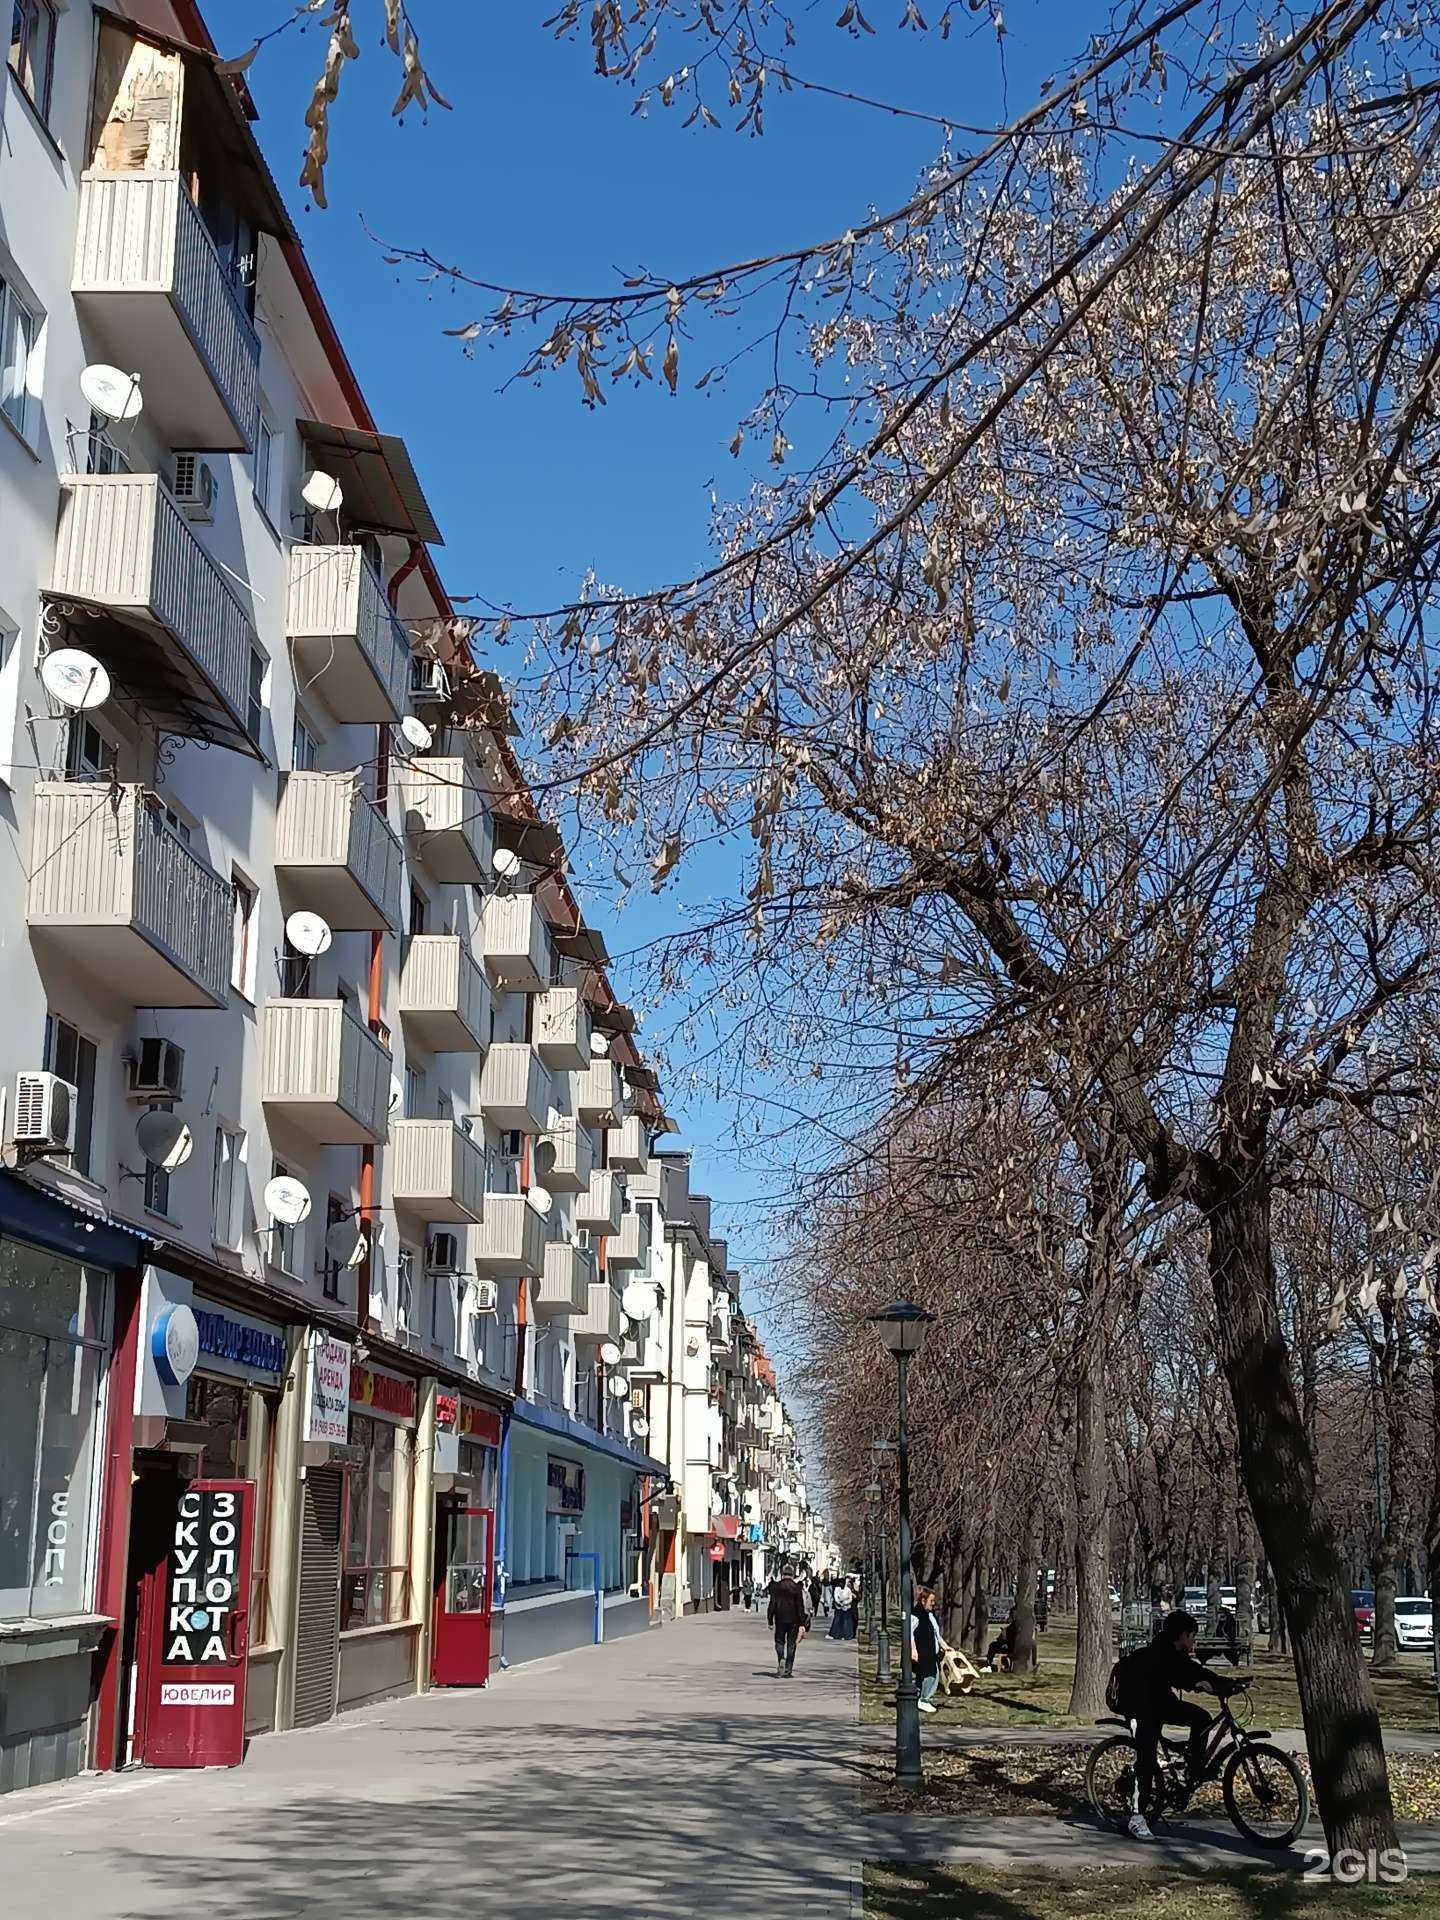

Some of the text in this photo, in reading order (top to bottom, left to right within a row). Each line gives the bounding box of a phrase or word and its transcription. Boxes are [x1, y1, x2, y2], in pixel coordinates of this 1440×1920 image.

[319, 1367, 343, 1390] АРЕНДА
[166, 1493, 200, 1661] СКУПКА
[200, 1493, 236, 1661] ЗОЛОТА
[164, 1688, 232, 1701] ЮВЕЛИР
